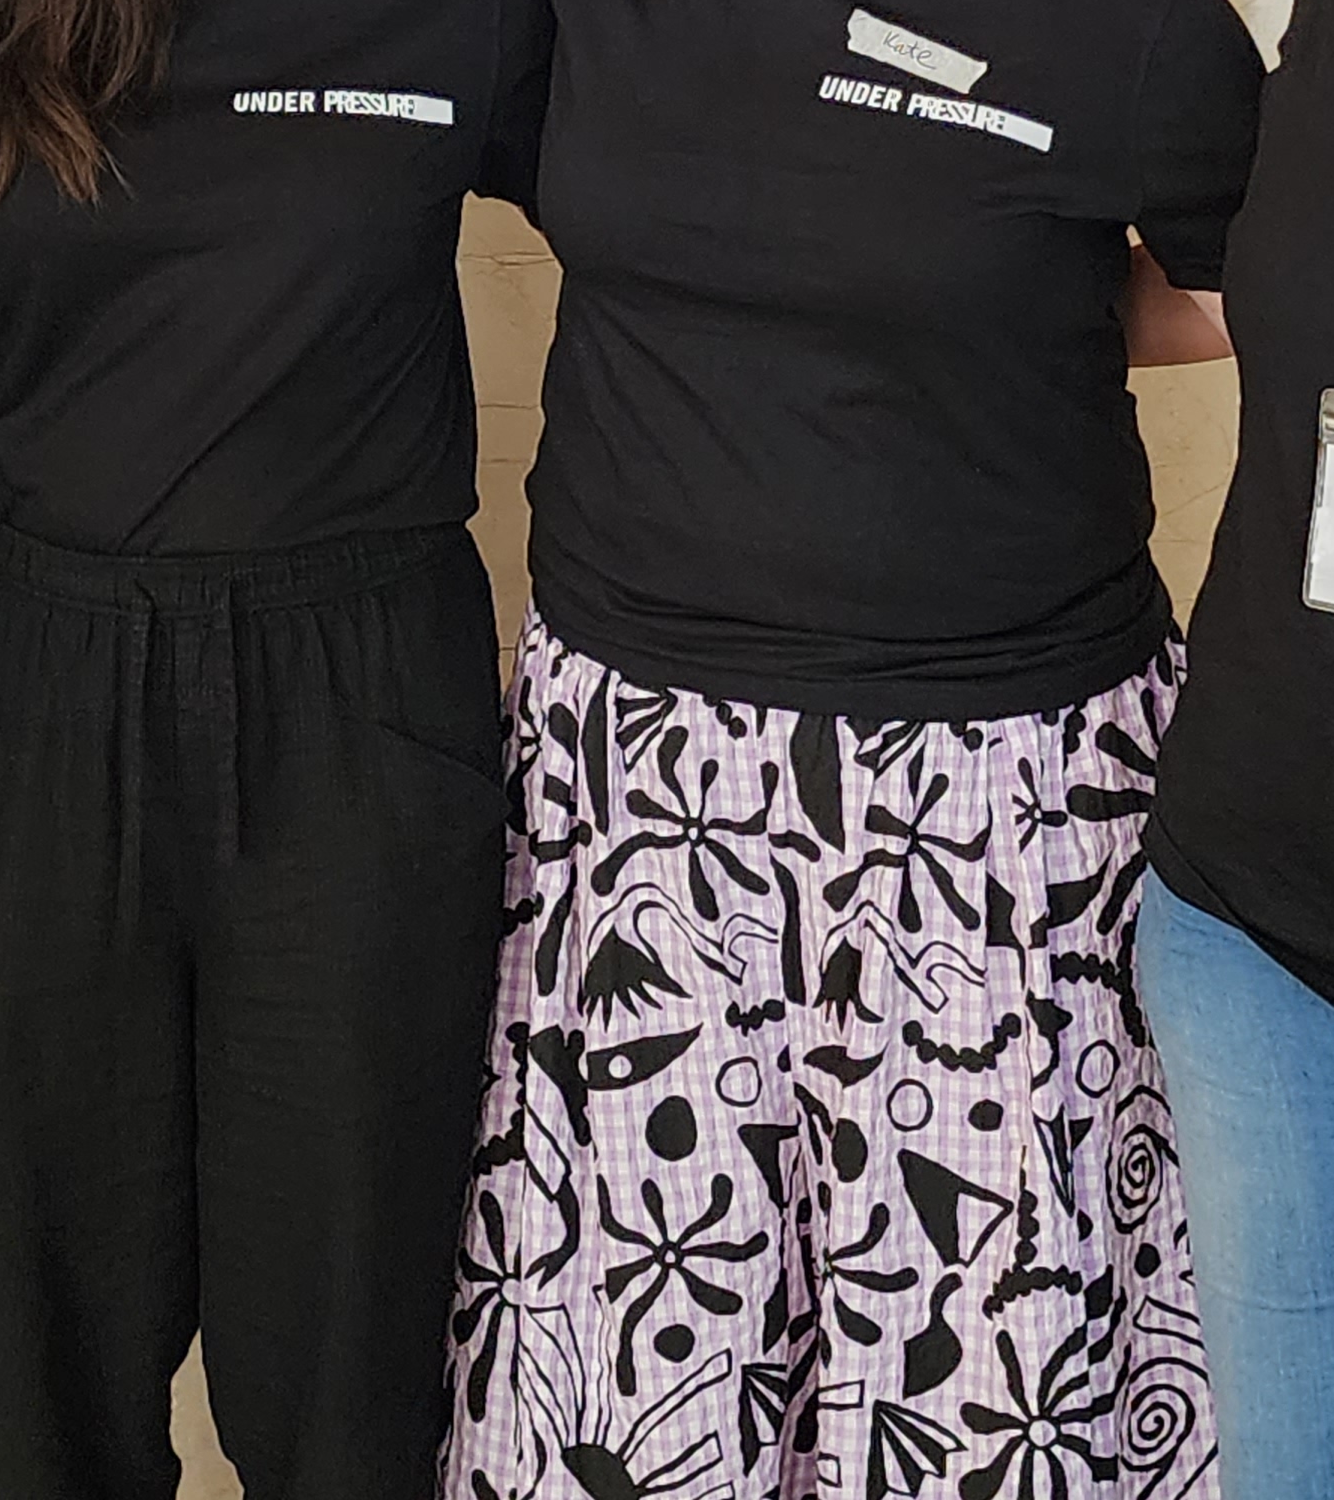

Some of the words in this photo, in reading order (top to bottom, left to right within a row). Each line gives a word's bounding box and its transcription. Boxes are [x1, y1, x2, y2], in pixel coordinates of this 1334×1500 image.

[883, 30, 936, 70] Kate
[233, 91, 316, 113] UNDER
[324, 90, 419, 118] PRESSURE
[818, 75, 902, 113] UNDER
[906, 93, 1012, 135] PRESSURE
